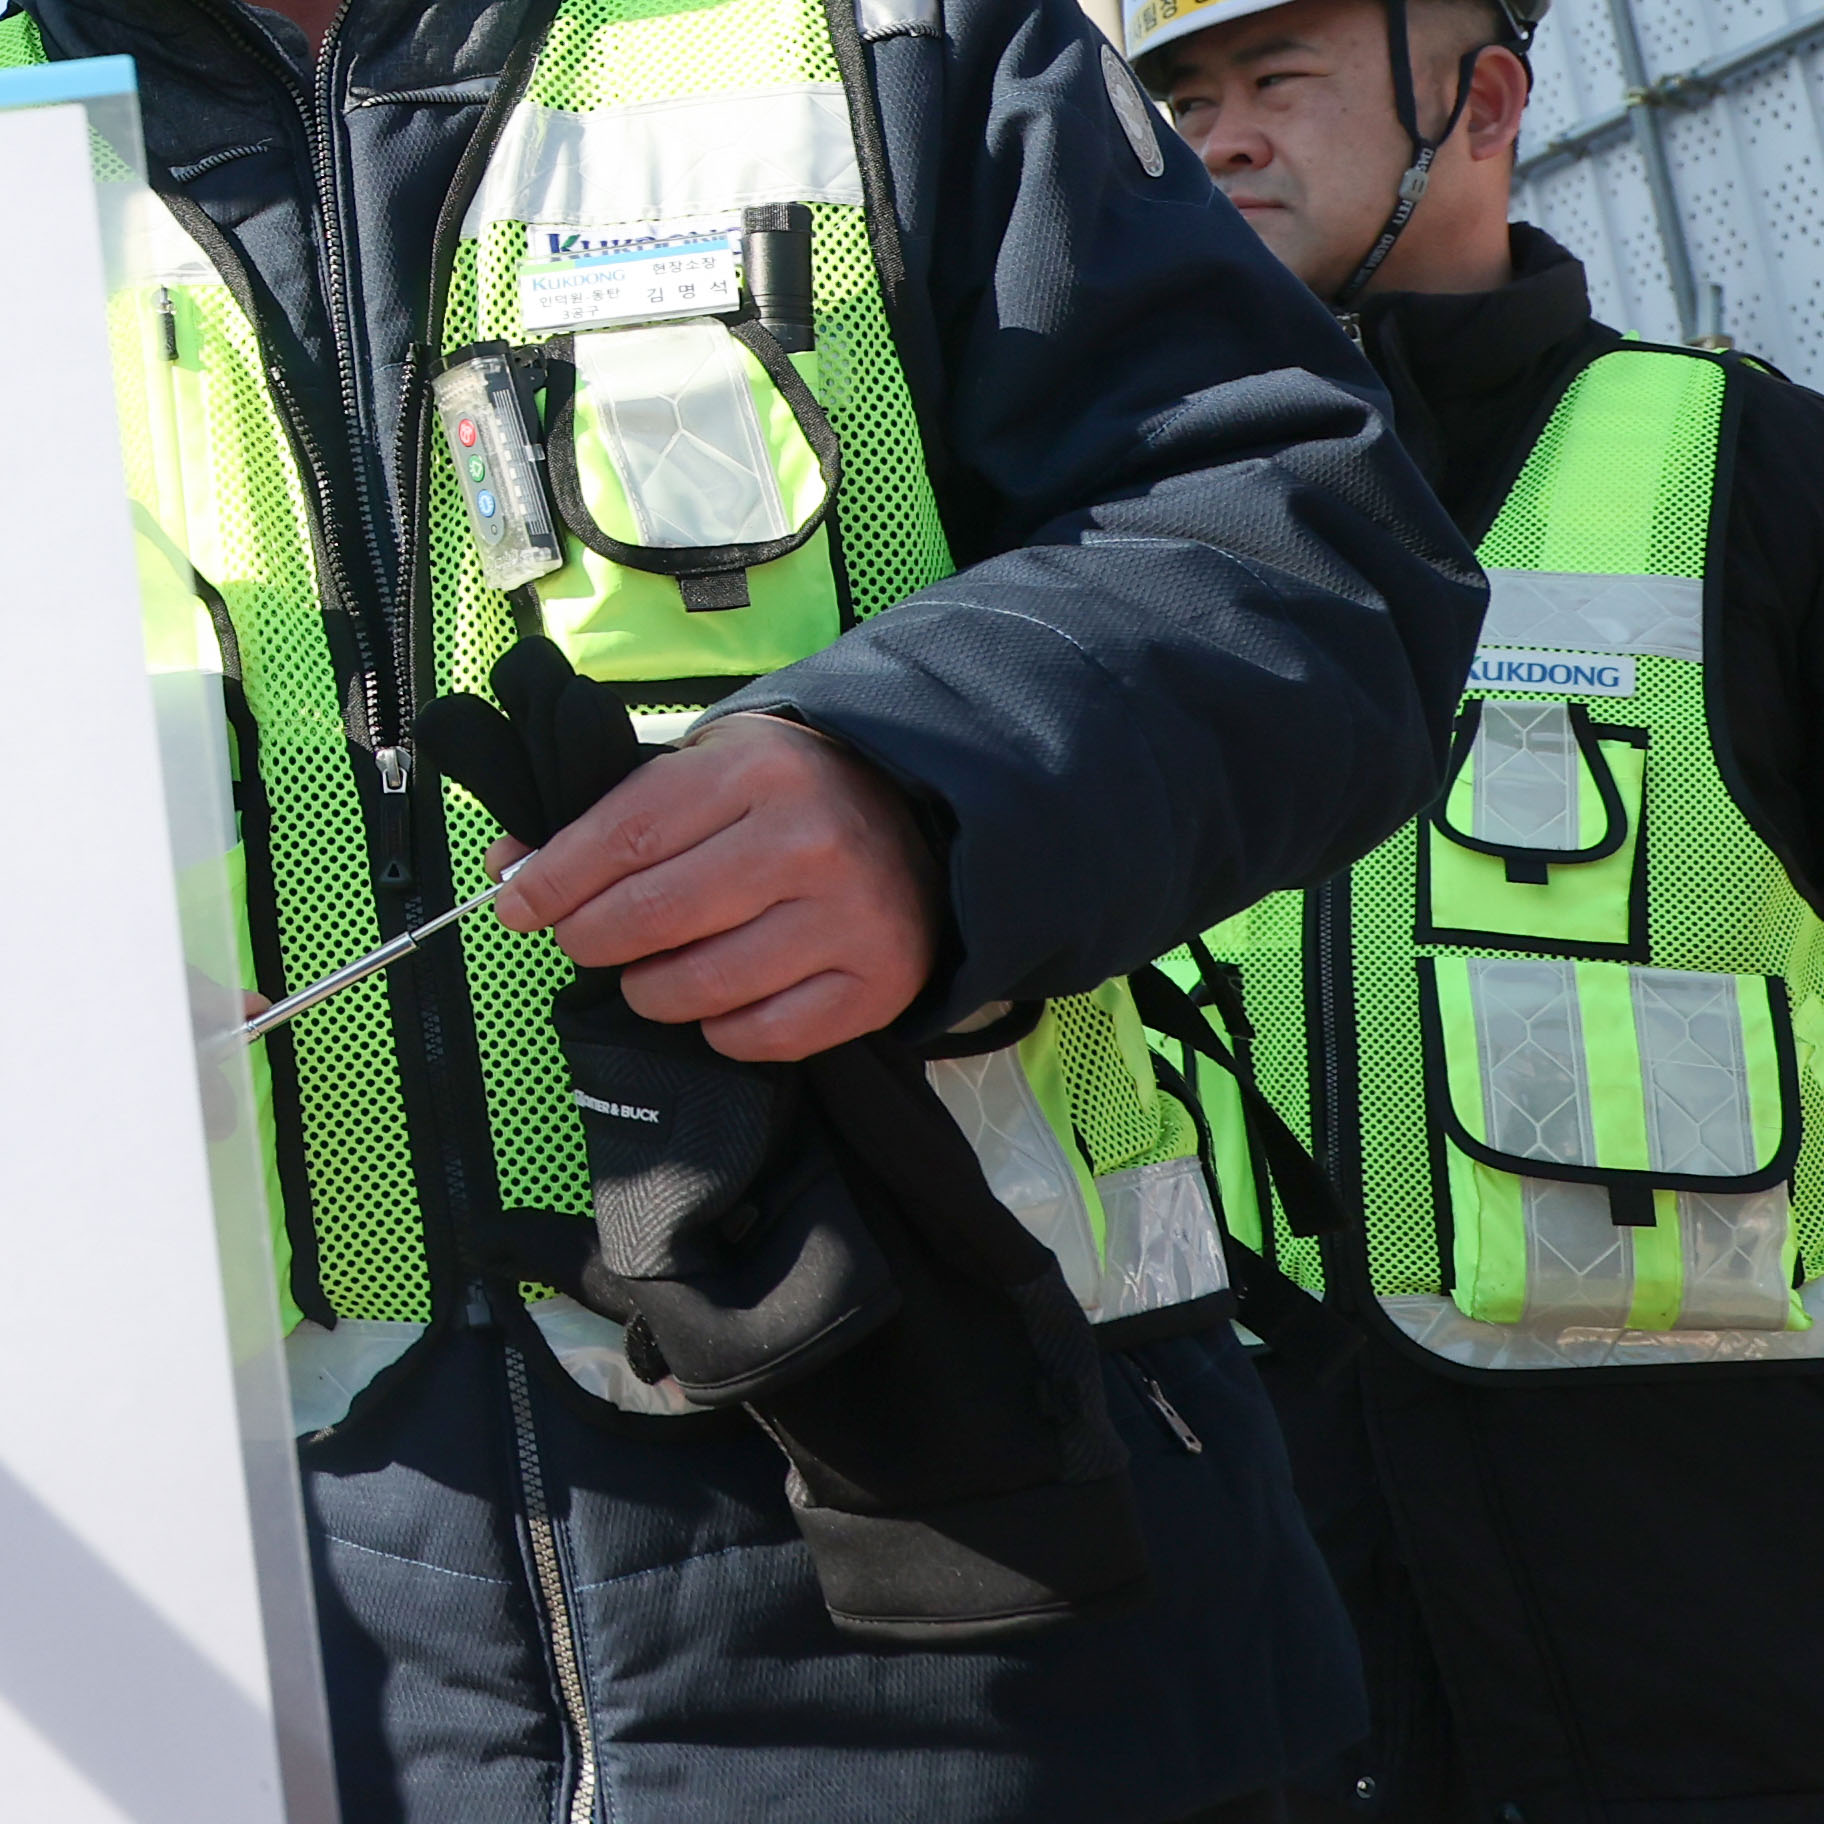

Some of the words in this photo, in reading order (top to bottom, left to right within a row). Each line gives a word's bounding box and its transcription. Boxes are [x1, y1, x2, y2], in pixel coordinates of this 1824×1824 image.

[653, 256, 716, 274] 현장소장
[532, 269, 625, 291] KUKDONG
[620, 1104, 660, 1124] BUCK
